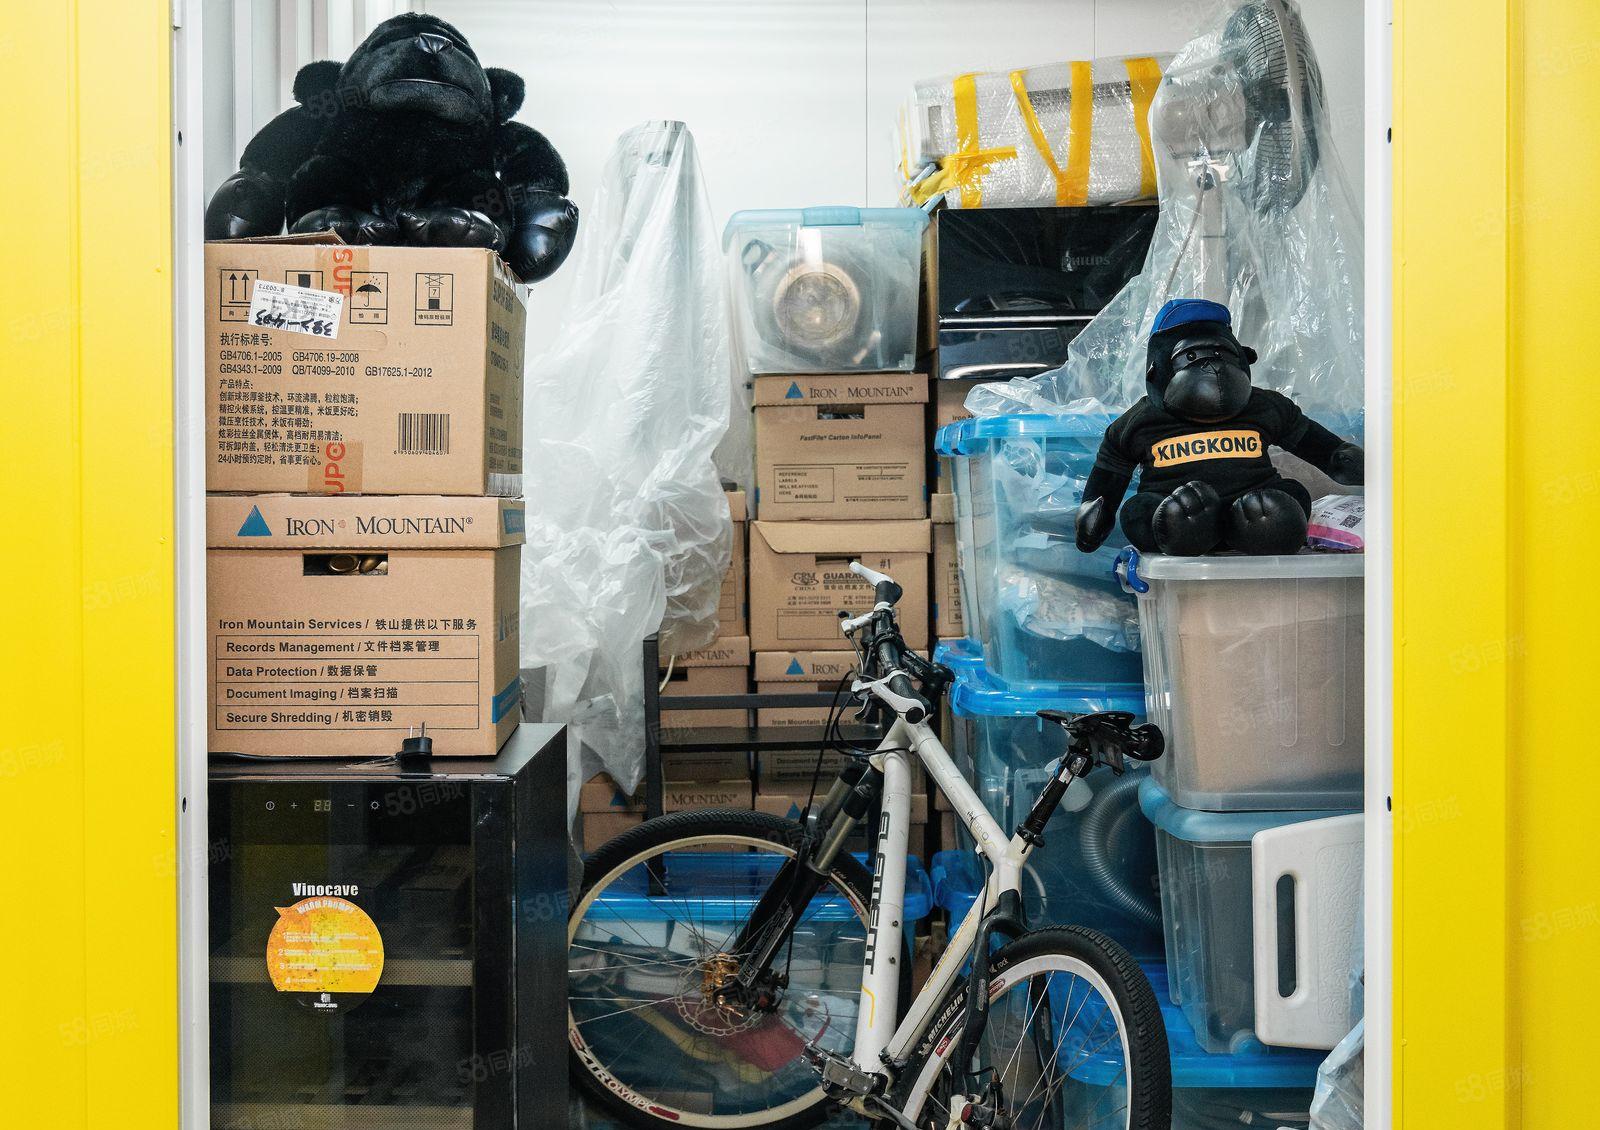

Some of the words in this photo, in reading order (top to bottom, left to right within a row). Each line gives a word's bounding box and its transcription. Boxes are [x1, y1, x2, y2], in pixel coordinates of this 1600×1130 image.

[220, 351, 282, 362] GB4706.1-2005
[292, 352, 360, 363] GB4706.19-2008
[219, 364, 282, 375] GB4343.1-2009
[292, 366, 355, 376] QB/T4099-2010
[365, 367, 433, 378] GB17625.1-2012
[810, 388, 837, 399] IRON
[1157, 436, 1259, 461] KINGKONG
[286, 517, 335, 536] IRON
[880, 558, 891, 569] #1
[219, 619, 244, 629] Iron
[247, 619, 305, 629] Mountain
[308, 619, 362, 629] Services
[375, 618, 478, 631] 铁山提供以下服务
[227, 642, 276, 653] Records
[279, 642, 355, 656] Management
[364, 640, 440, 653] 文件档案管理
[227, 666, 253, 677] Data
[256, 666, 317, 677] Protection
[327, 665, 378, 678] 数据保管
[812, 663, 839, 674] IRON
[226, 688, 287, 700] Document
[290, 688, 337, 702] Imaging
[347, 687, 398, 700] 档案扫描
[226, 712, 268, 723] Secure
[271, 711, 332, 726] Shredding
[342, 710, 392, 723] 机密销毁
[292, 883, 359, 896] Vinocave
[927, 993, 964, 1042] MICHELIN
